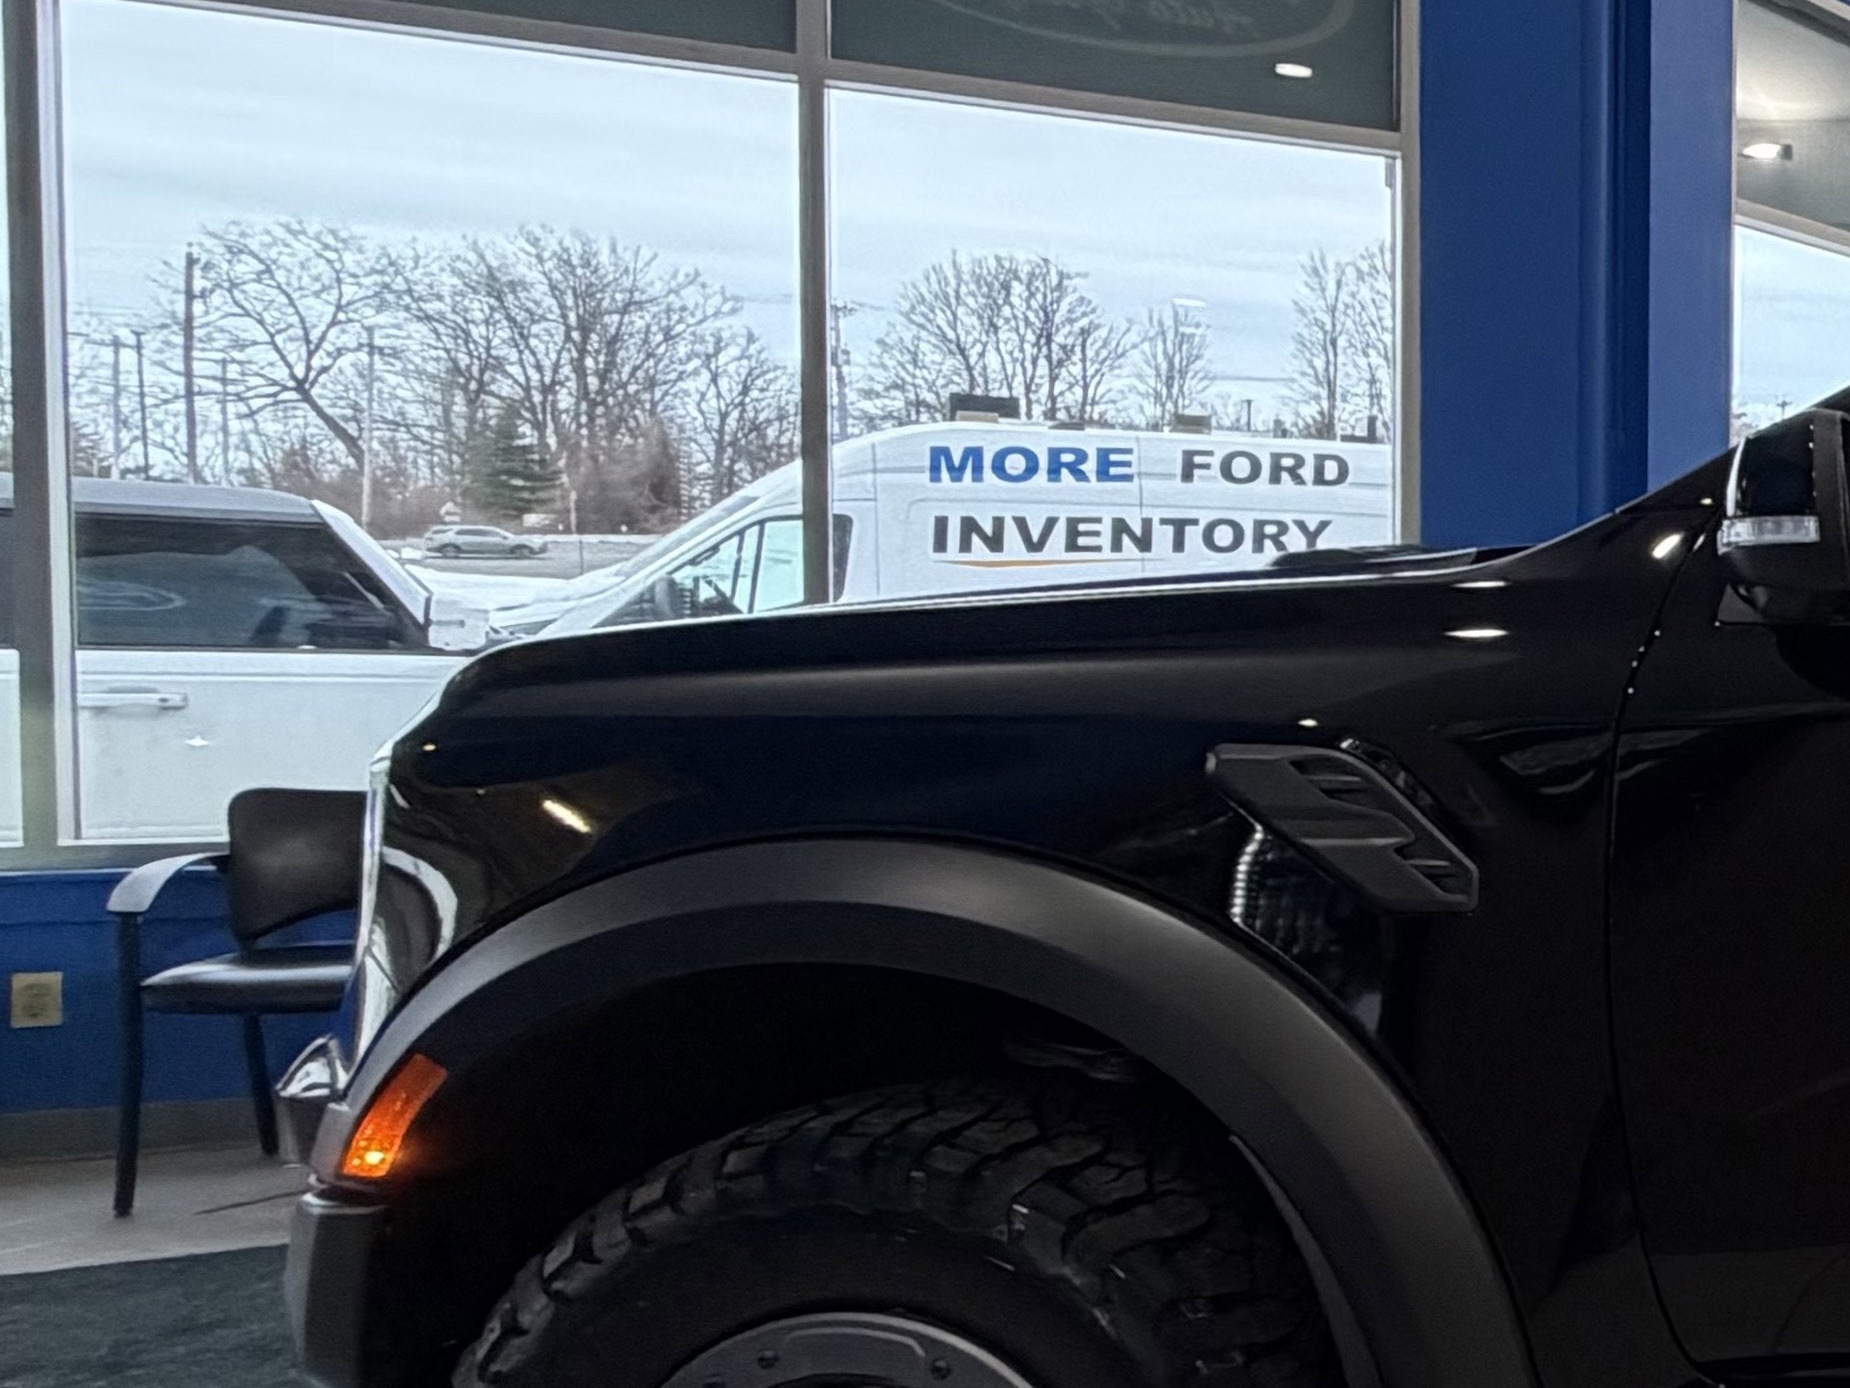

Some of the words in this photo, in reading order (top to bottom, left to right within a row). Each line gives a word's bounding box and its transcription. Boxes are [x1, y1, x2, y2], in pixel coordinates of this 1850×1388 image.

[928, 445, 1135, 484] MORE
[1179, 449, 1351, 487] FORD
[931, 515, 1333, 555] INVENTORY
